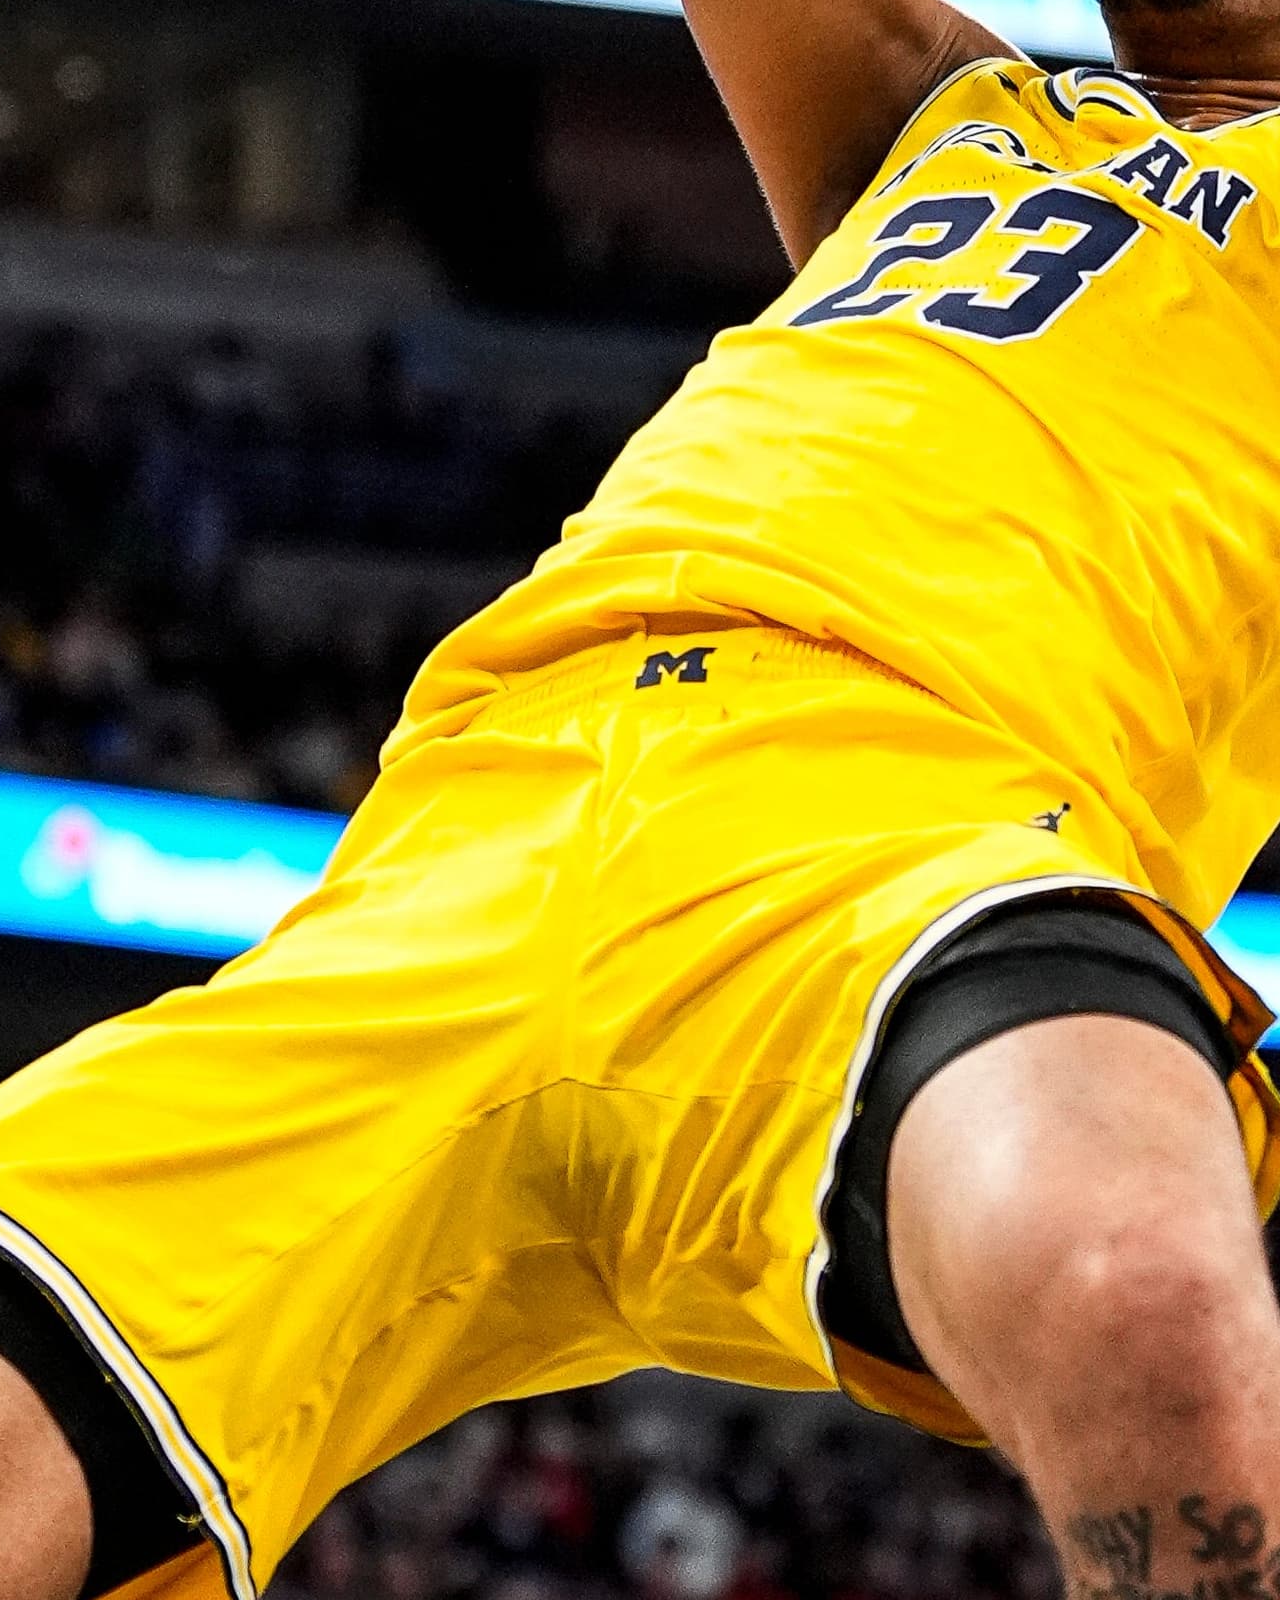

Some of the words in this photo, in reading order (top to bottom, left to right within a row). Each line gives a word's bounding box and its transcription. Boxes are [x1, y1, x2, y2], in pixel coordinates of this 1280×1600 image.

[785, 185, 1145, 345] 23
[634, 646, 718, 691] M
[1180, 1492, 1267, 1564] SO
